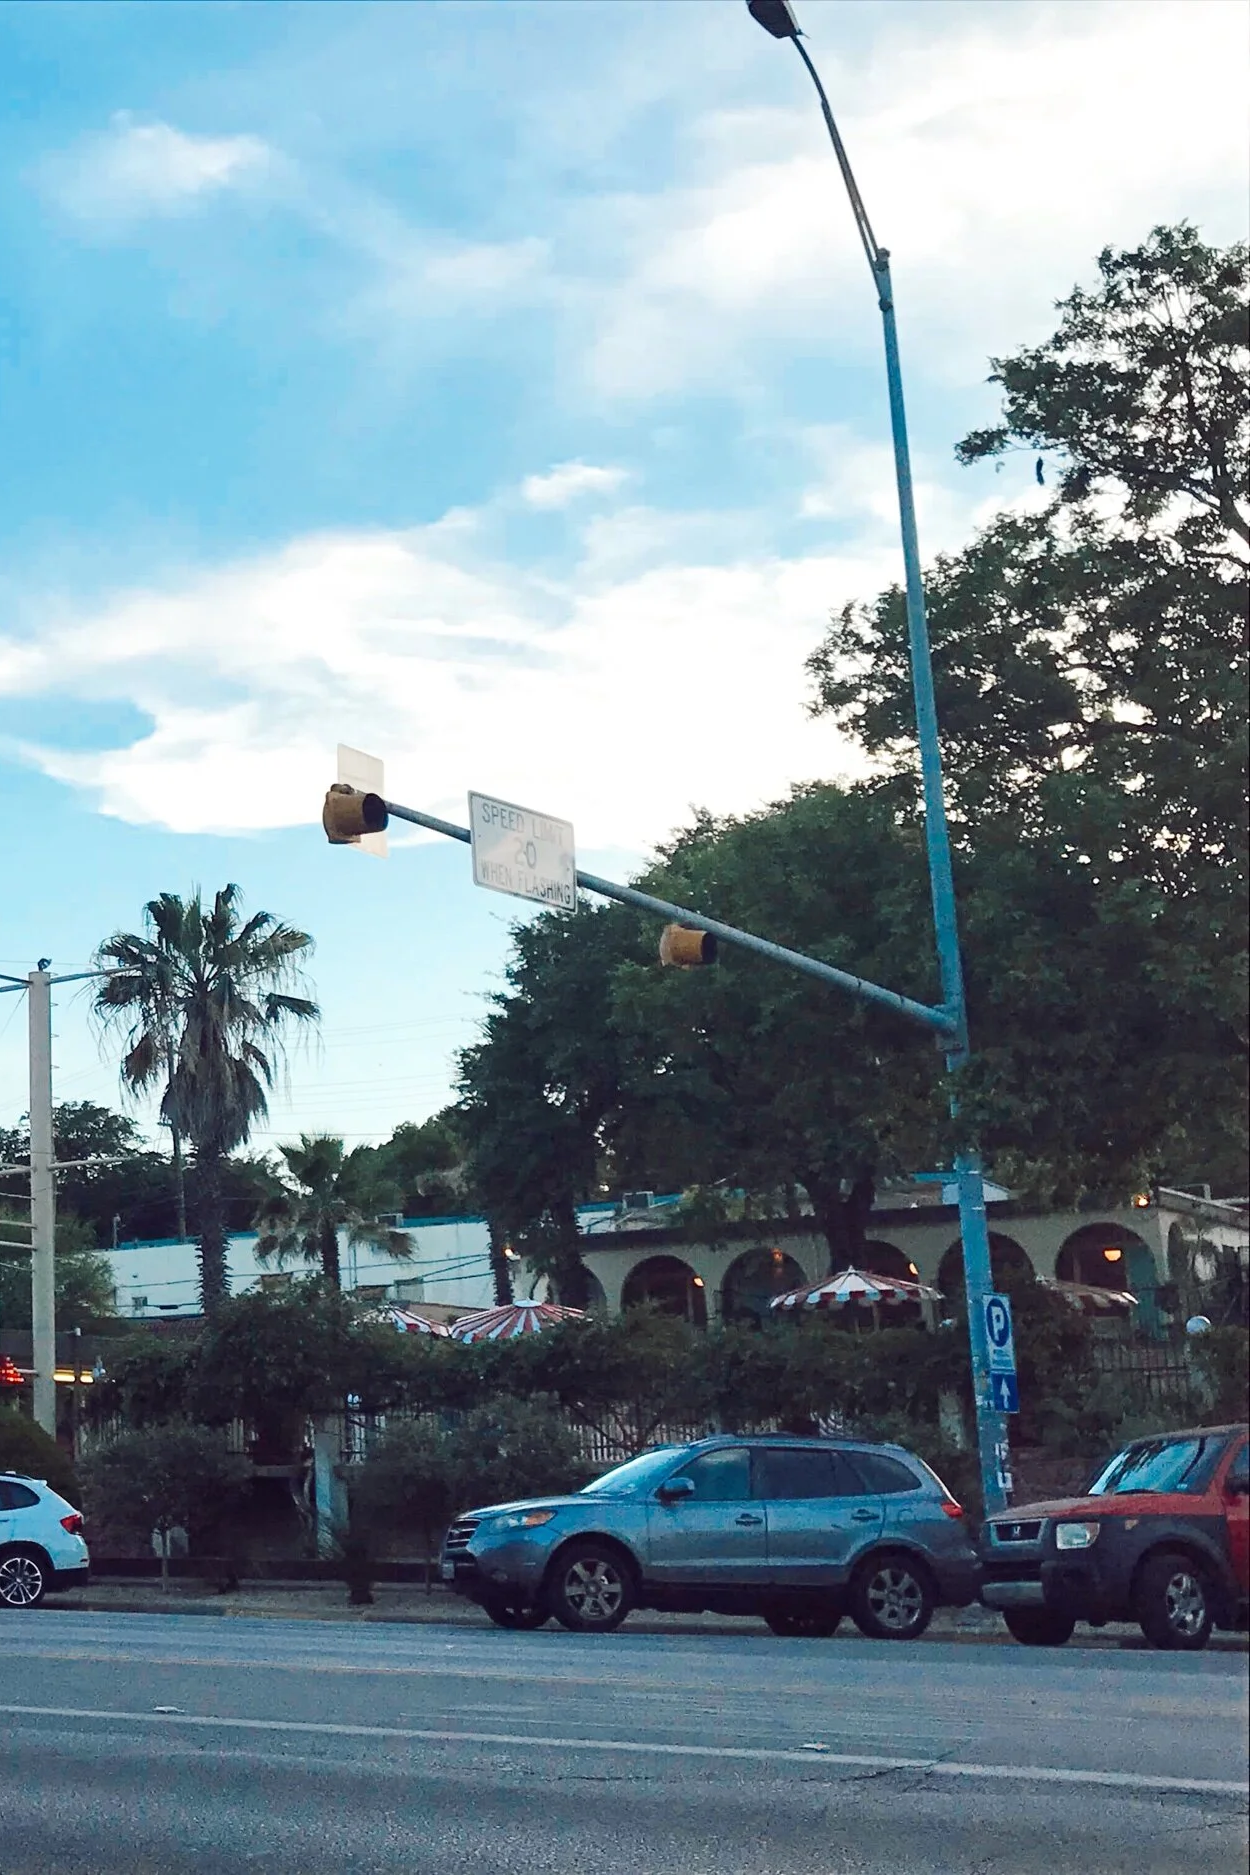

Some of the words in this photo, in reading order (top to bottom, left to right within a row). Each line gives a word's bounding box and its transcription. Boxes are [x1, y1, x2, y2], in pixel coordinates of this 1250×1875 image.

[482, 802, 525, 833] SPEED
[532, 818, 564, 847] LIMIT
[513, 837, 537, 869] 20
[481, 858, 513, 887] WHEN
[517, 870, 571, 905] FLASHING
[990, 1305, 1005, 1342] P
